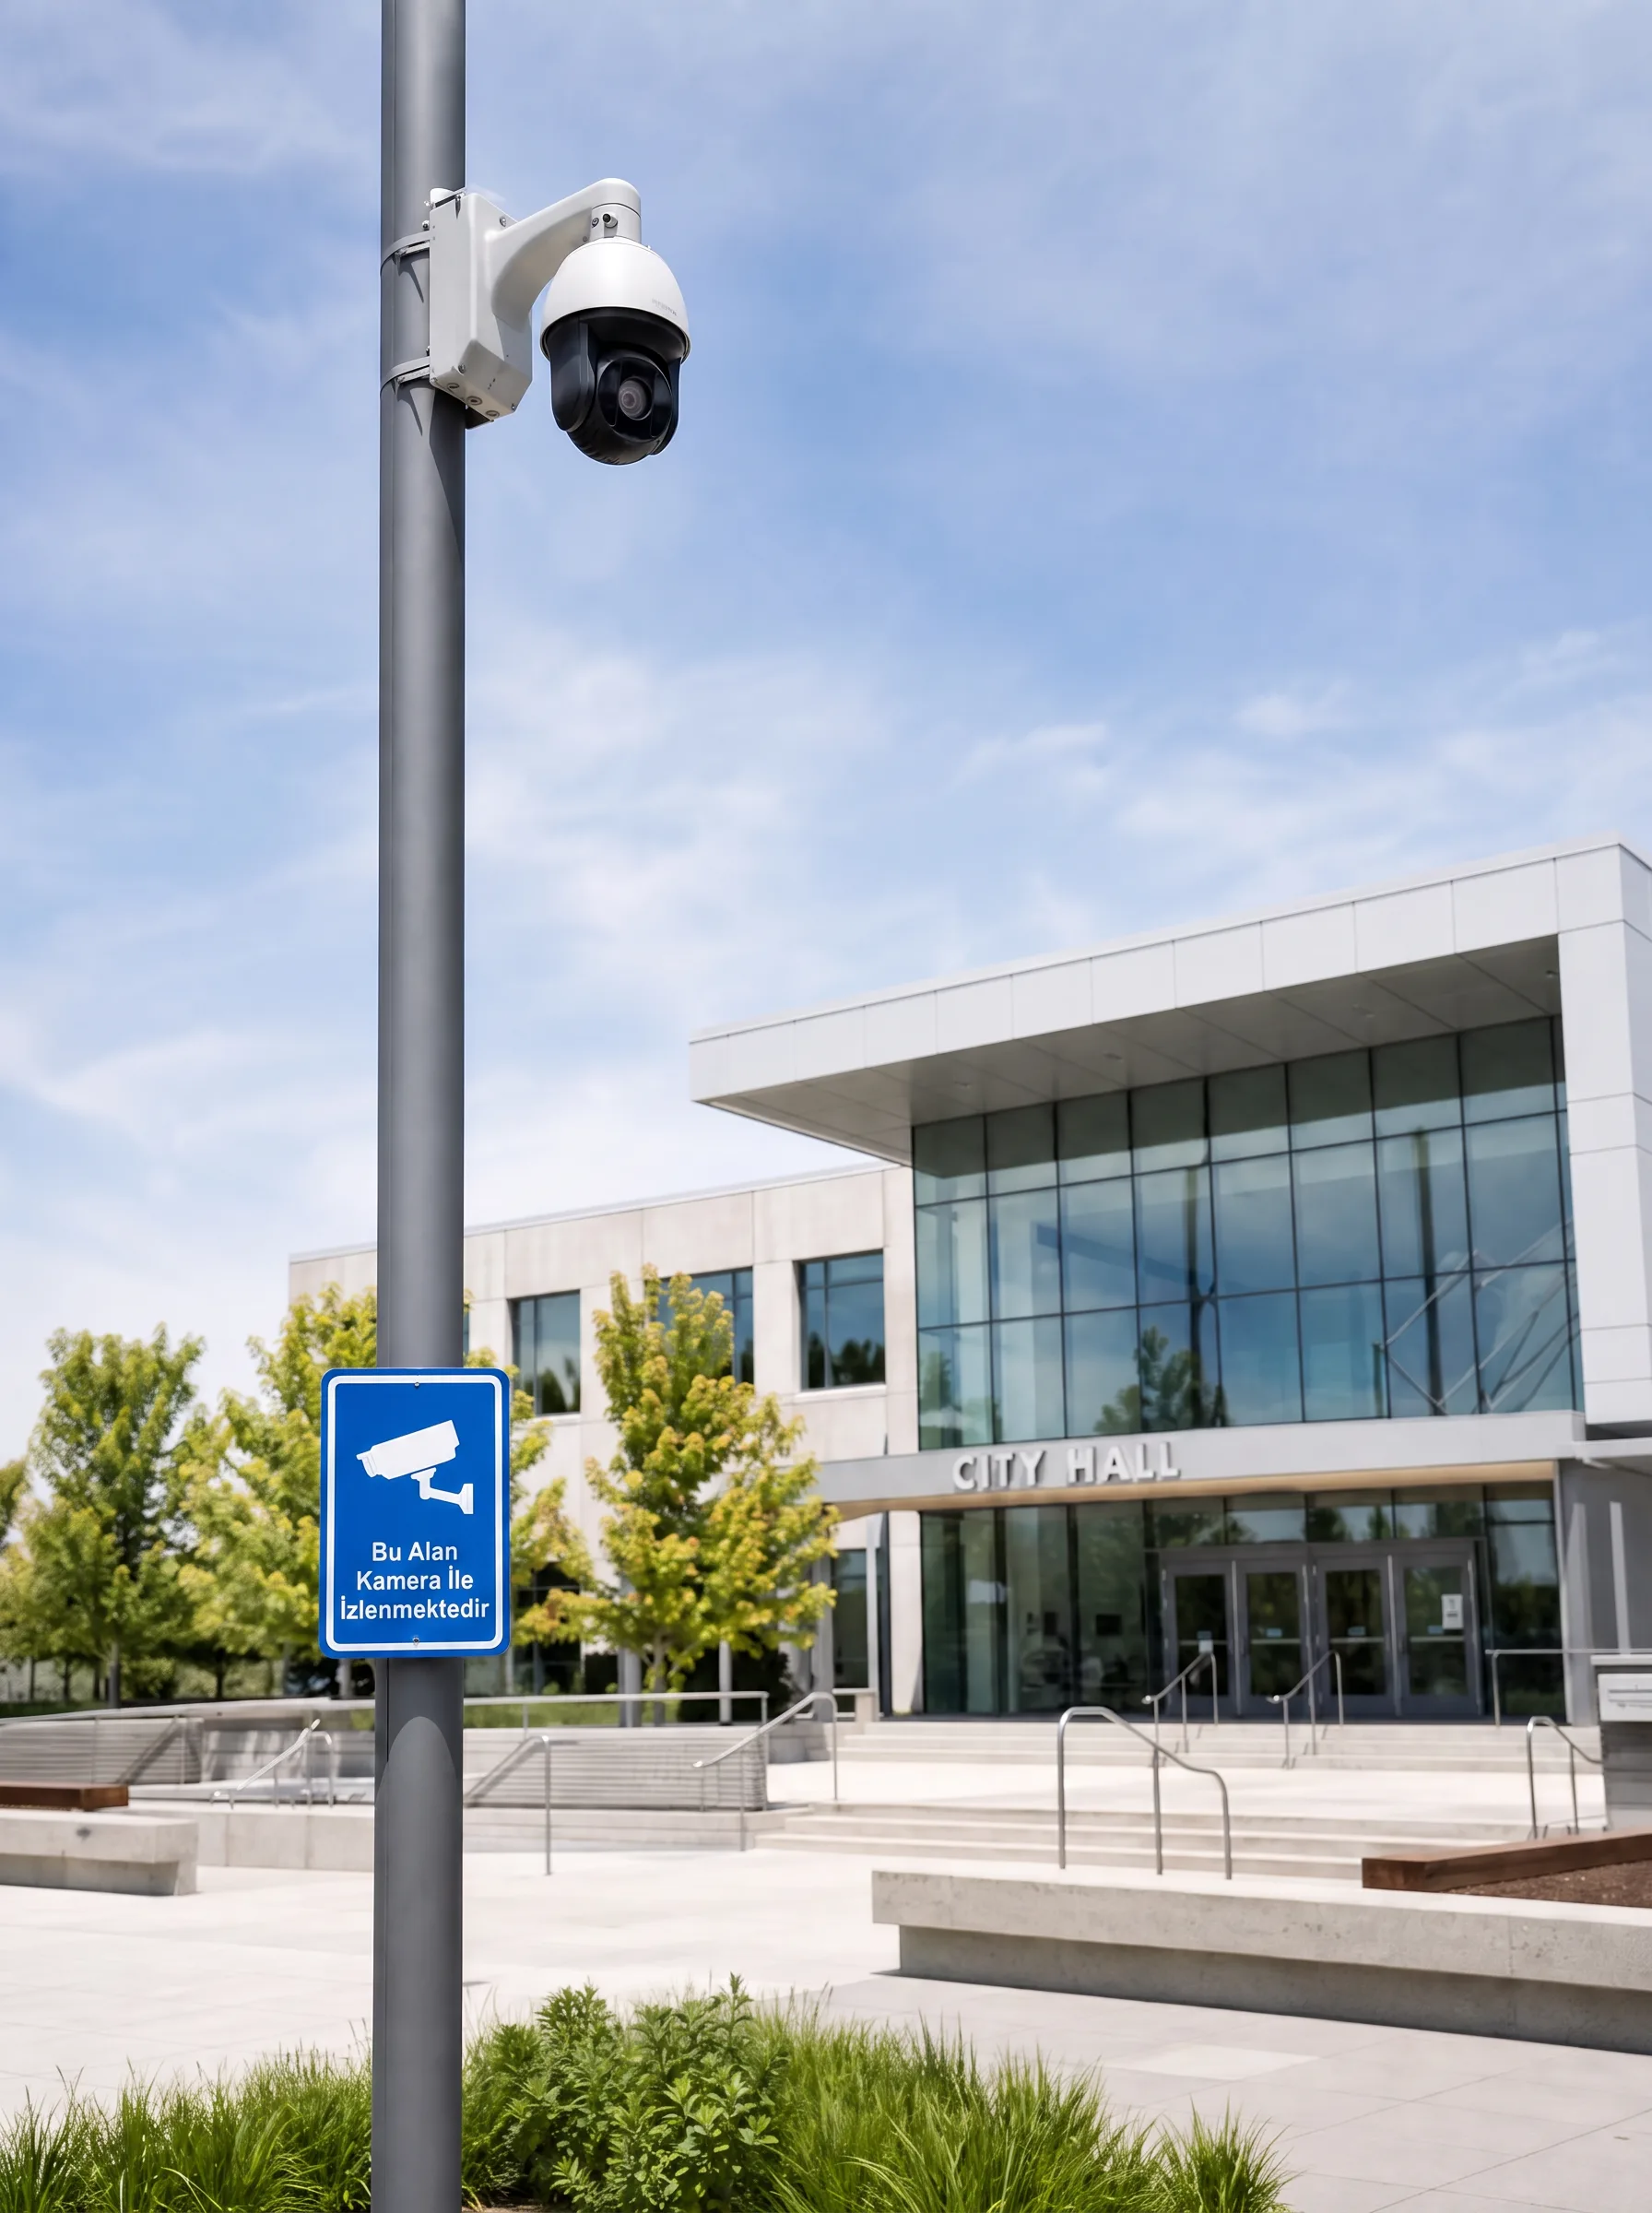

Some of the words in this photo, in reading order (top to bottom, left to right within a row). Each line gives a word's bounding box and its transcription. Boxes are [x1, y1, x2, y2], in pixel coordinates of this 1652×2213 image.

[952, 1450, 1045, 1491] CITY
[1067, 1441, 1180, 1483] HALL
[372, 1542, 402, 1562] Bu
[407, 1541, 457, 1561] Alan
[357, 1570, 442, 1591] Kamera
[448, 1565, 474, 1590] İle
[340, 1595, 490, 1620] İzlenmektedir
